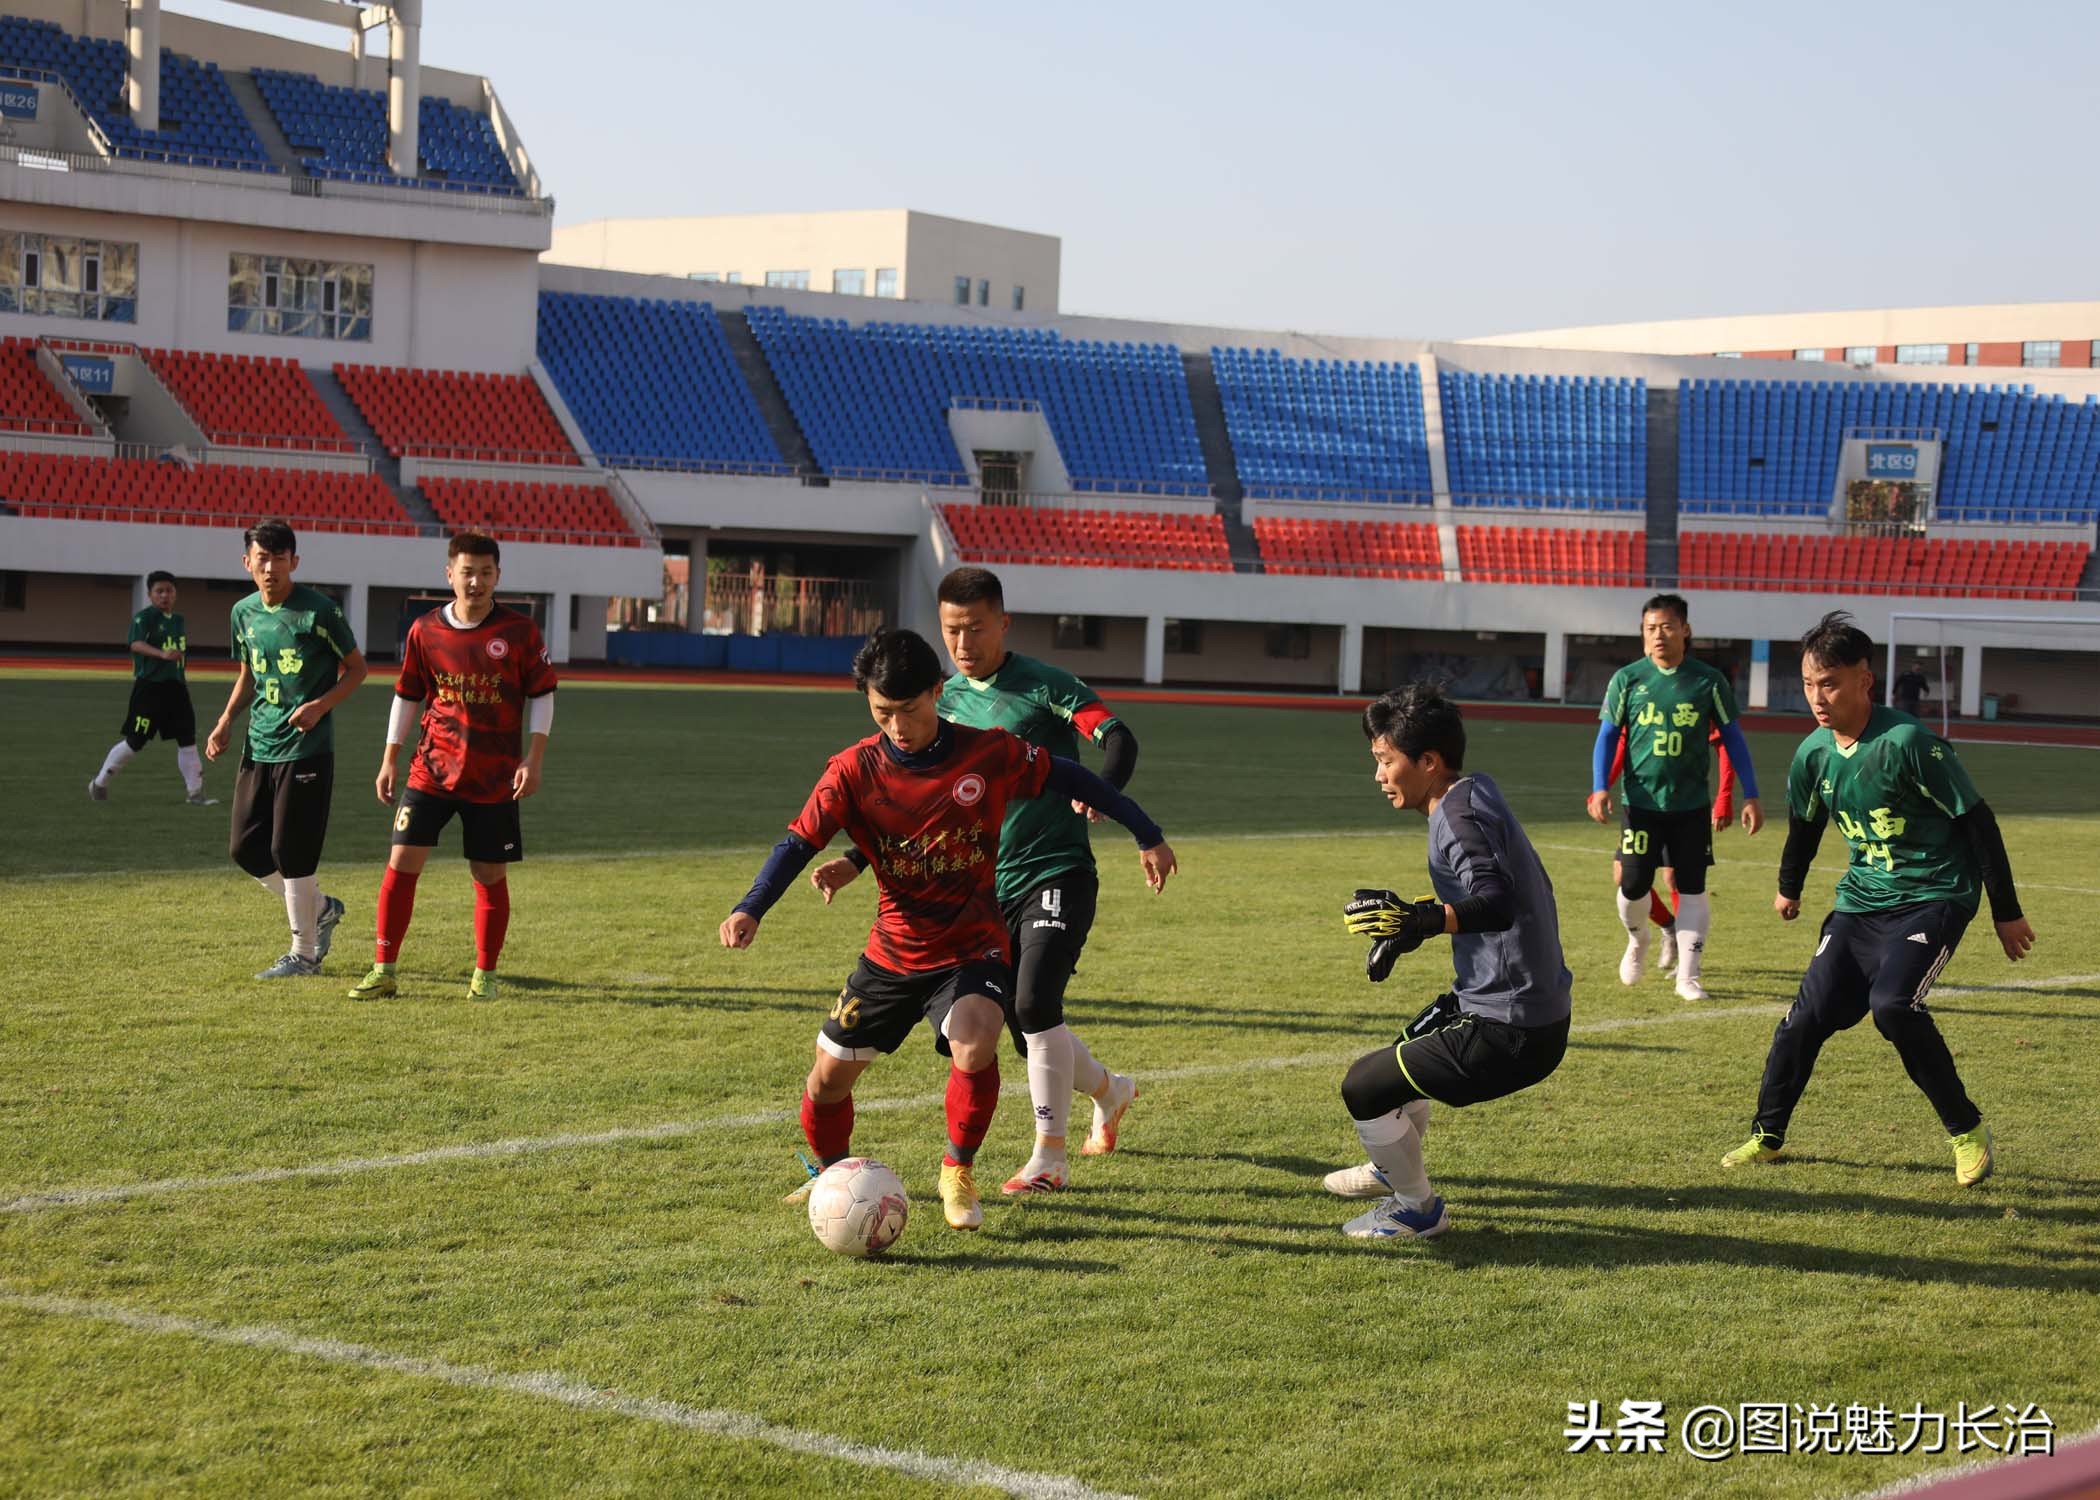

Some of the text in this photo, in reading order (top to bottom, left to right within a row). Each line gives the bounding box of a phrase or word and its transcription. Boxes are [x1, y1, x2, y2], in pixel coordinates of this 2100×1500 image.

[265, 678, 279, 705] 6
[134, 716, 150, 734] 19
[1637, 702, 1699, 727] 山西
[1652, 730, 1683, 757] 20
[393, 806, 411, 832] 6
[1622, 829, 1648, 854] 20
[1041, 888, 1061, 917] 4
[1346, 899, 1377, 912] KELME
